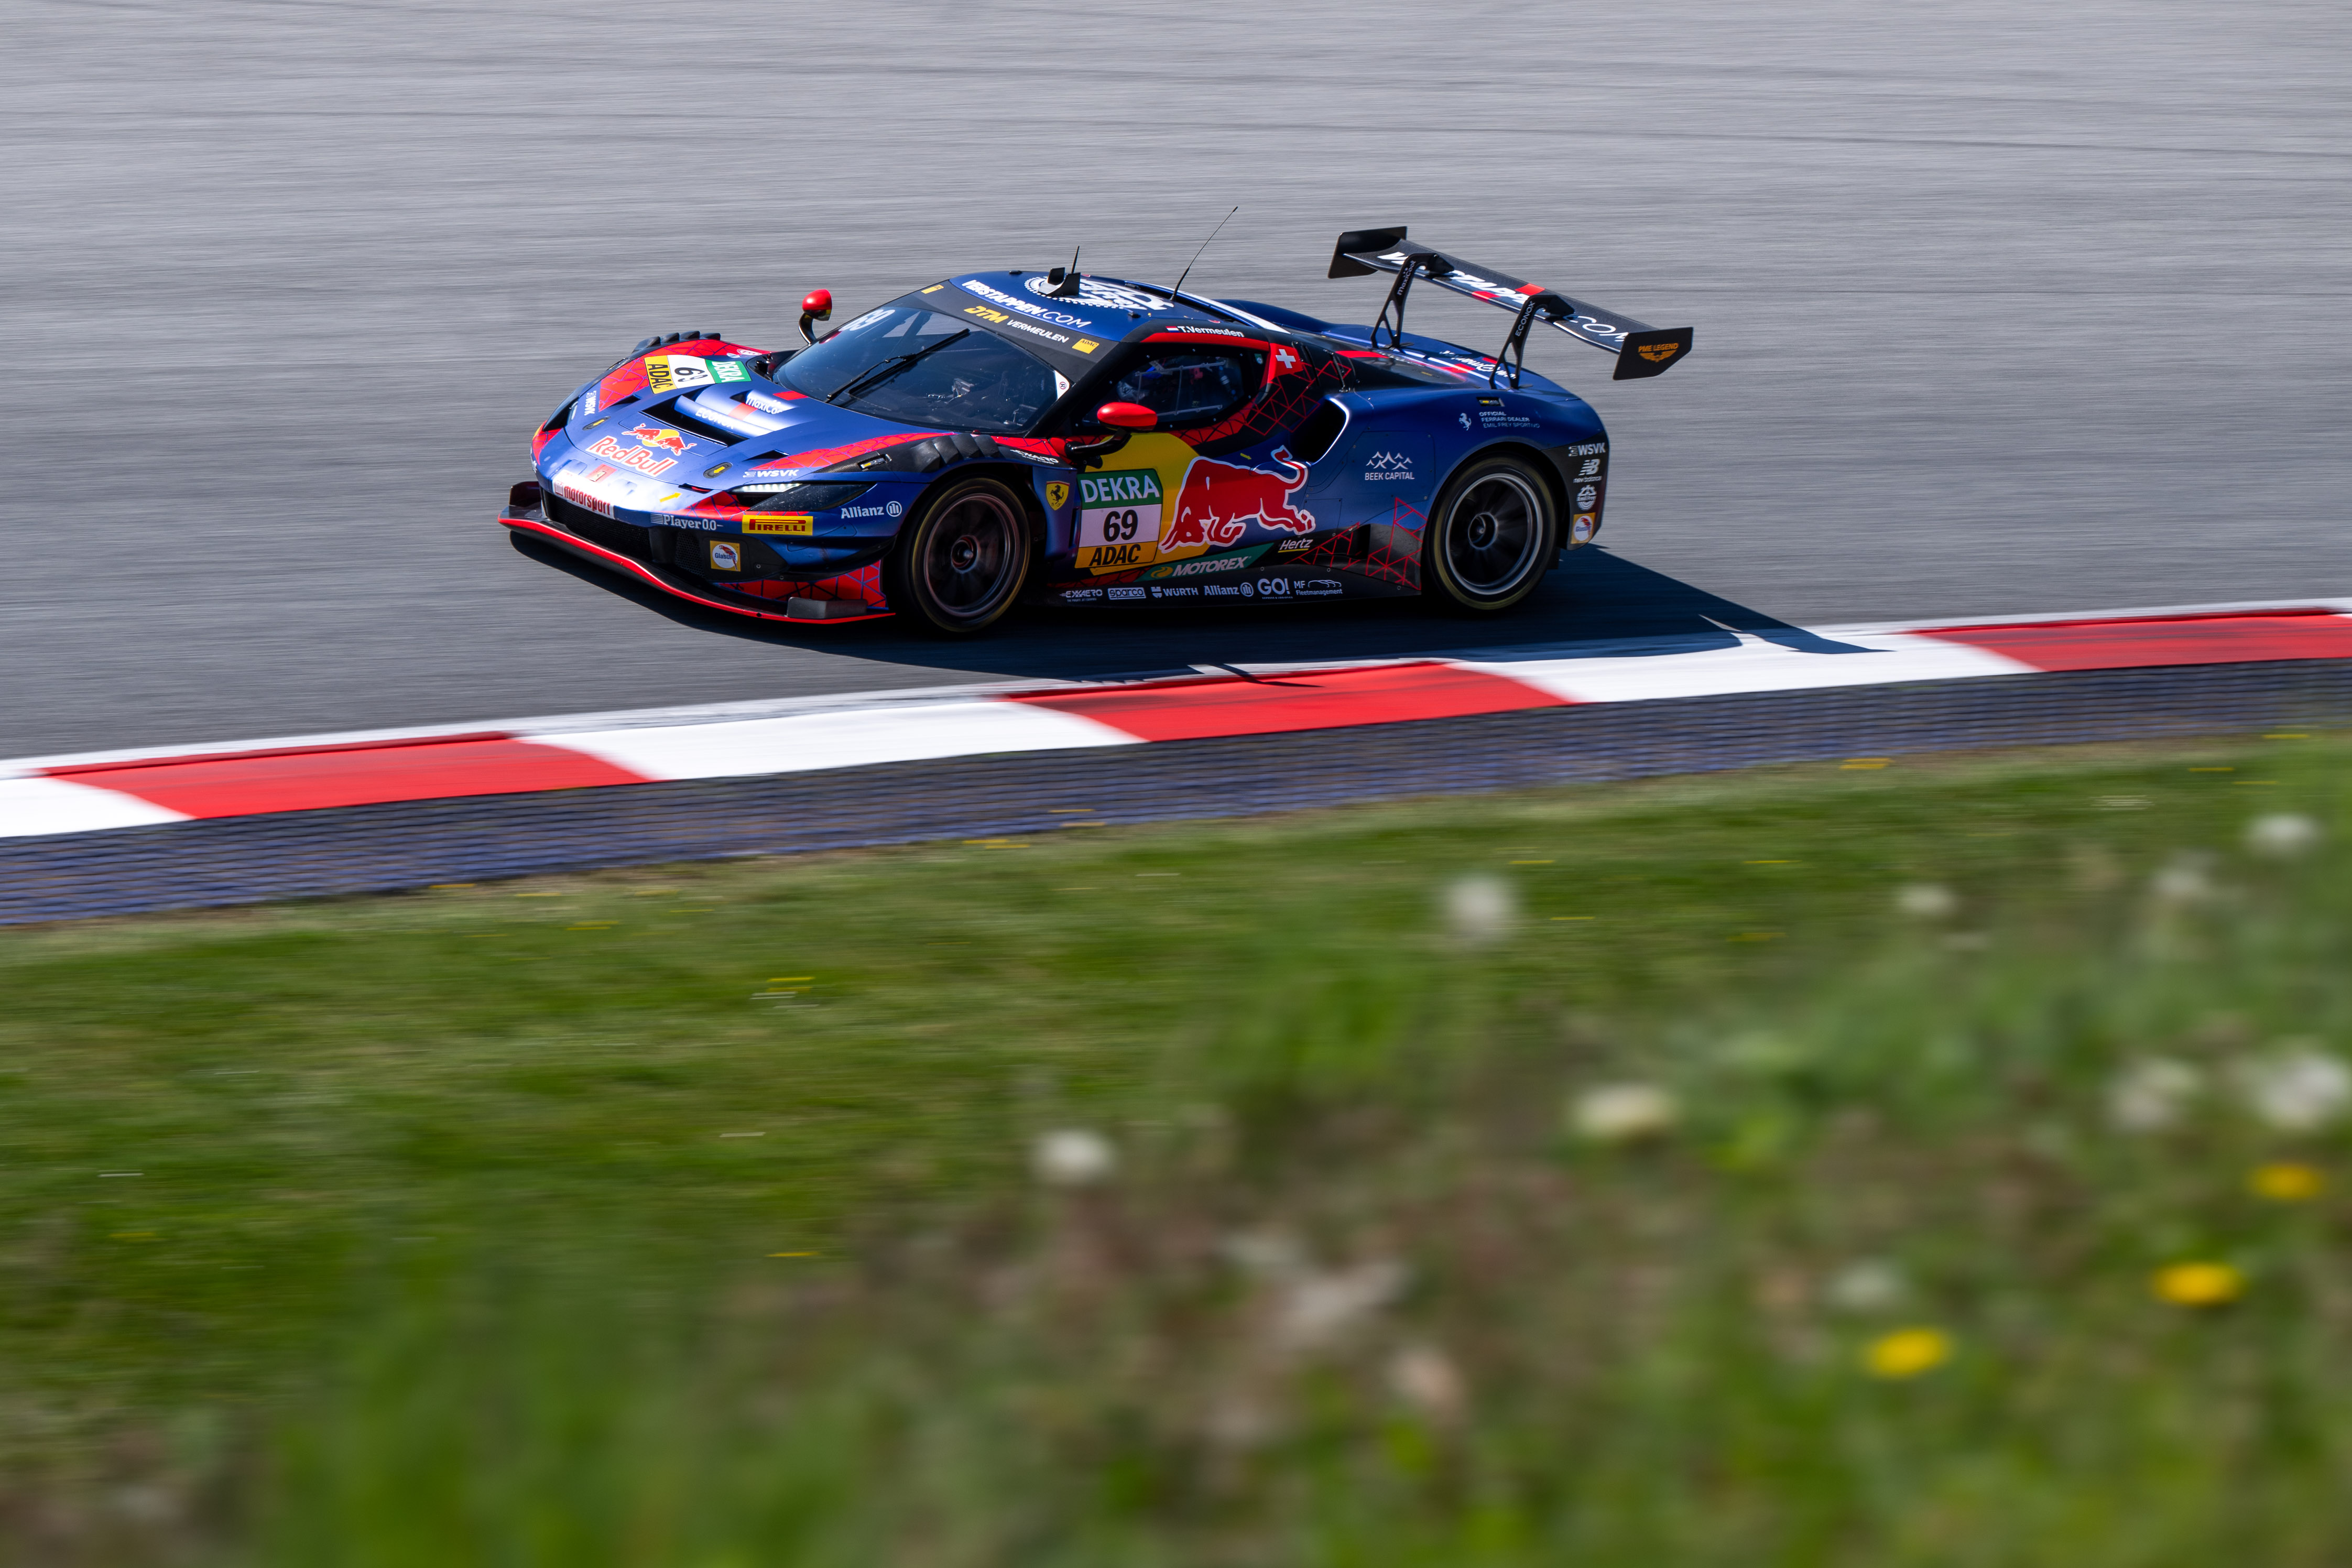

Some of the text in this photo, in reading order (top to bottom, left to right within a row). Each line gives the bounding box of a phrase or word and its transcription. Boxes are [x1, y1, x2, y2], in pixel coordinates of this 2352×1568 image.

[962, 280, 1091, 328] VERSTAPPEN.COM
[964, 306, 1009, 323] DTM
[1515, 301, 1536, 337] ECONOX
[1007, 319, 1069, 343] VERMEULEN
[1177, 326, 1245, 337] T.Vermeulen
[1080, 339, 1099, 347] ADAC
[1653, 343, 1679, 351] LEGEND
[647, 364, 673, 389] ADAC
[674, 367, 708, 383] 69
[712, 361, 745, 383] DEKRA
[584, 396, 596, 416] WSVK
[587, 437, 676, 476] Red Bull
[1578, 442, 1606, 456] WSVK
[1365, 472, 1384, 481] BEEK
[1080, 475, 1160, 503] DEKRA
[564, 485, 611, 516] motorsport
[841, 506, 884, 519] Allianz
[663, 514, 701, 529] Player
[749, 519, 806, 531] PIRELLI
[1103, 509, 1138, 542] 69
[1279, 538, 1313, 550] Hertz
[1089, 544, 1141, 567] ADAC
[1172, 557, 1248, 576] MOTOREX
[1109, 587, 1144, 598] sparco
[1162, 587, 1199, 596] WÜRTH
[1204, 585, 1240, 596] Allianz
[1258, 578, 1290, 595] GO!
[1294, 581, 1305, 589] MF
